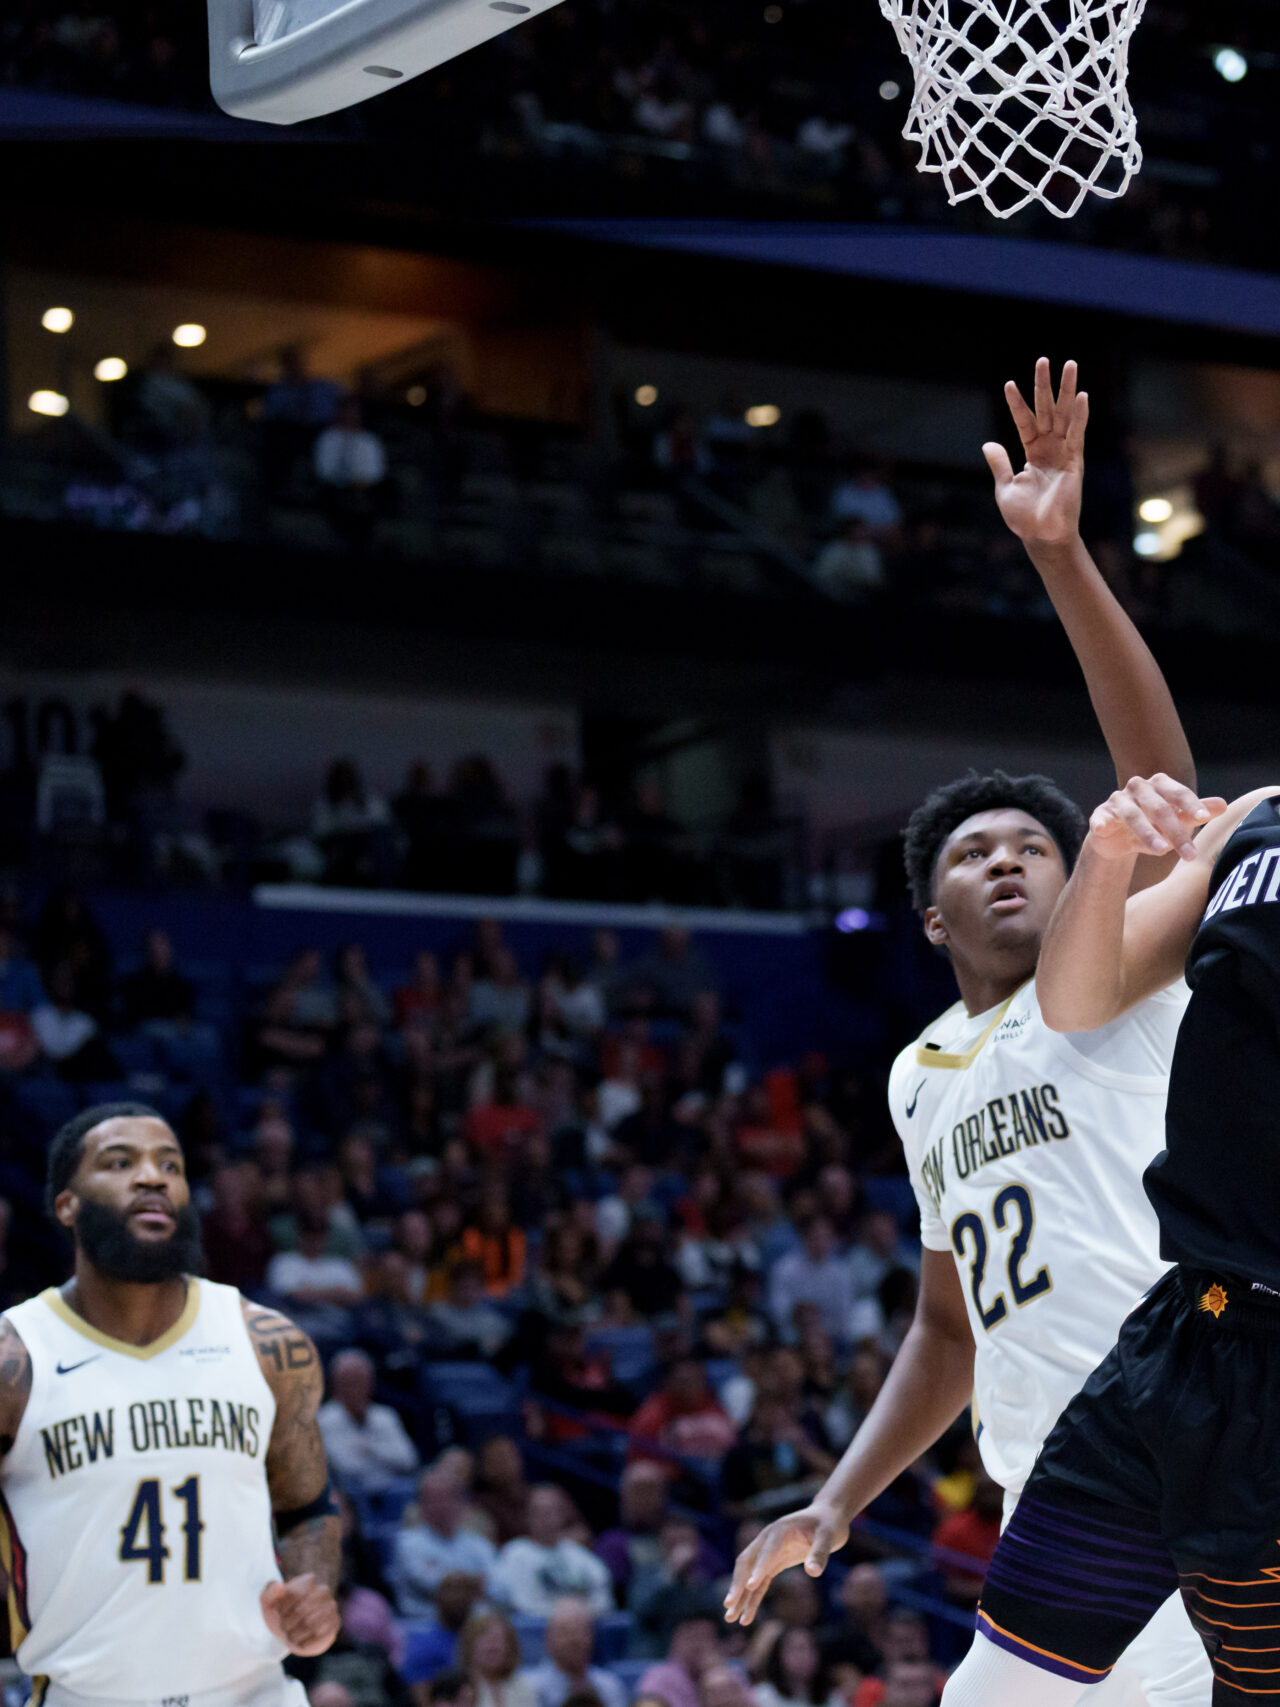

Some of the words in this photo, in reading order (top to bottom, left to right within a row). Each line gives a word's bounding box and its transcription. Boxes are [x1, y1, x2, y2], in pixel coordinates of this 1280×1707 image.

[952, 1083, 1070, 1181] ORLEANS
[951, 1181, 1053, 1334] 22
[40, 1407, 115, 1480] NEW
[128, 1397, 261, 1459] ORLEANS
[117, 1473, 206, 1586] 41
